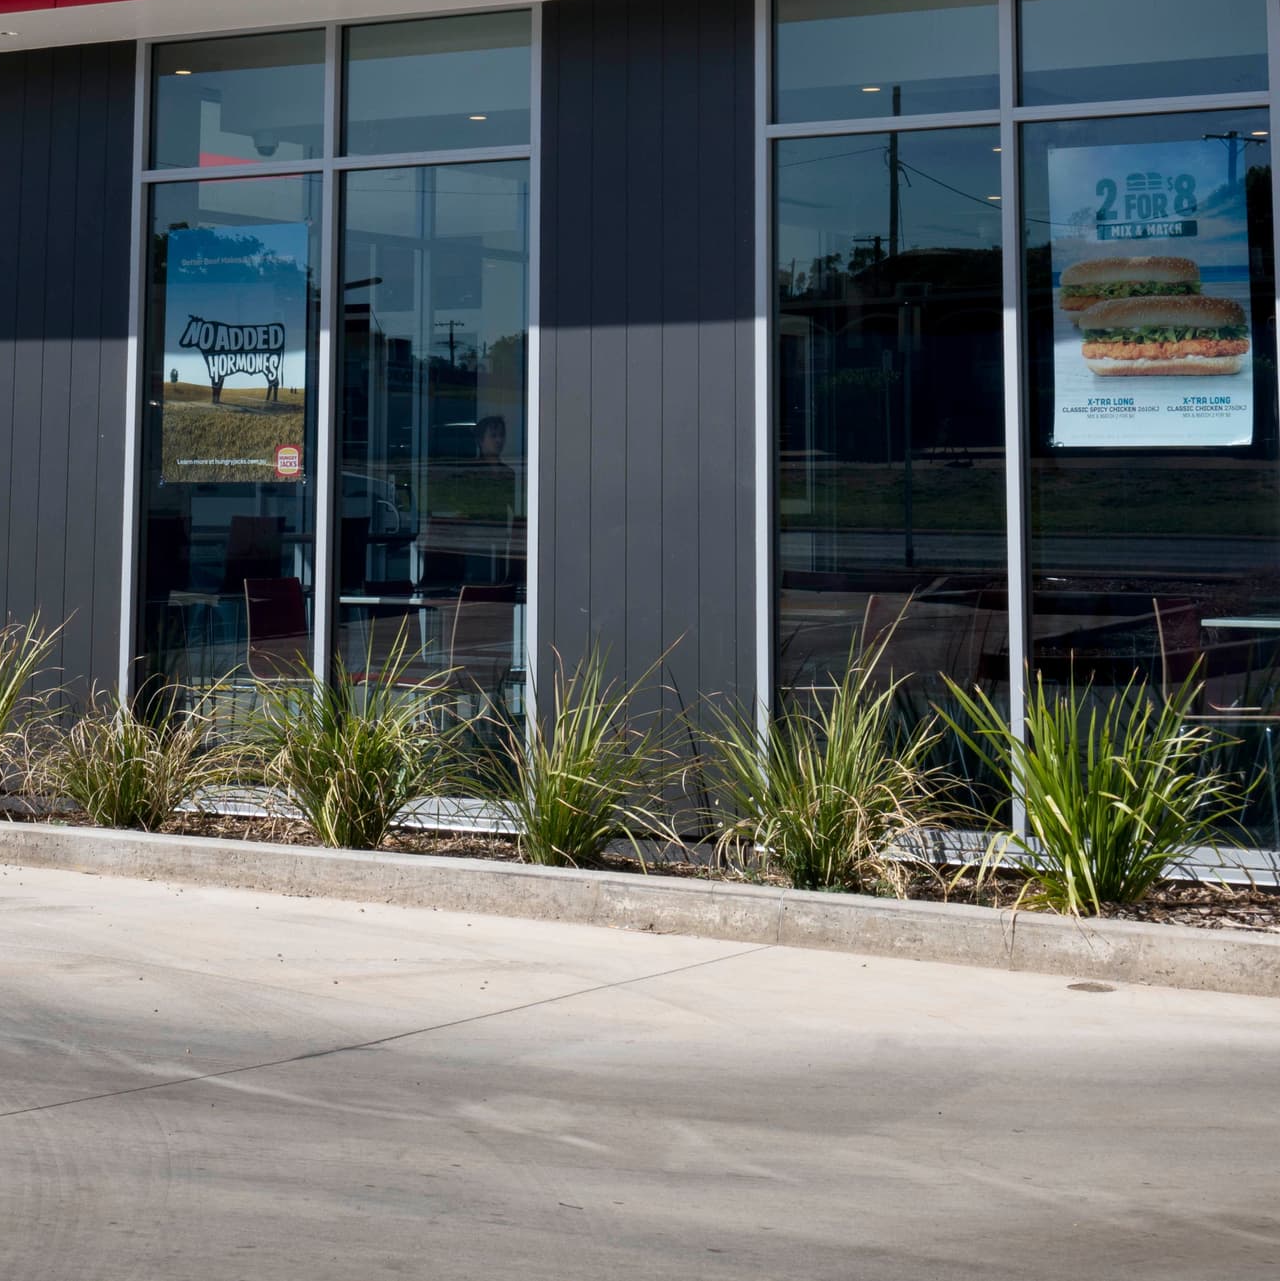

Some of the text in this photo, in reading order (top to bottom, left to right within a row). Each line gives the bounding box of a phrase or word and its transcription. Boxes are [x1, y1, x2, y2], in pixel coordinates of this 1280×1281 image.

[1096, 174, 1197, 220] 2 FOR $8
[1111, 225, 1132, 237] MIX
[1147, 223, 1183, 236] MATCH
[182, 321, 283, 351] NO ADDED
[208, 353, 279, 383] HORMONES
[1087, 398, 1135, 406] X-TRA LONG
[1183, 396, 1231, 405] X-TRA LONG
